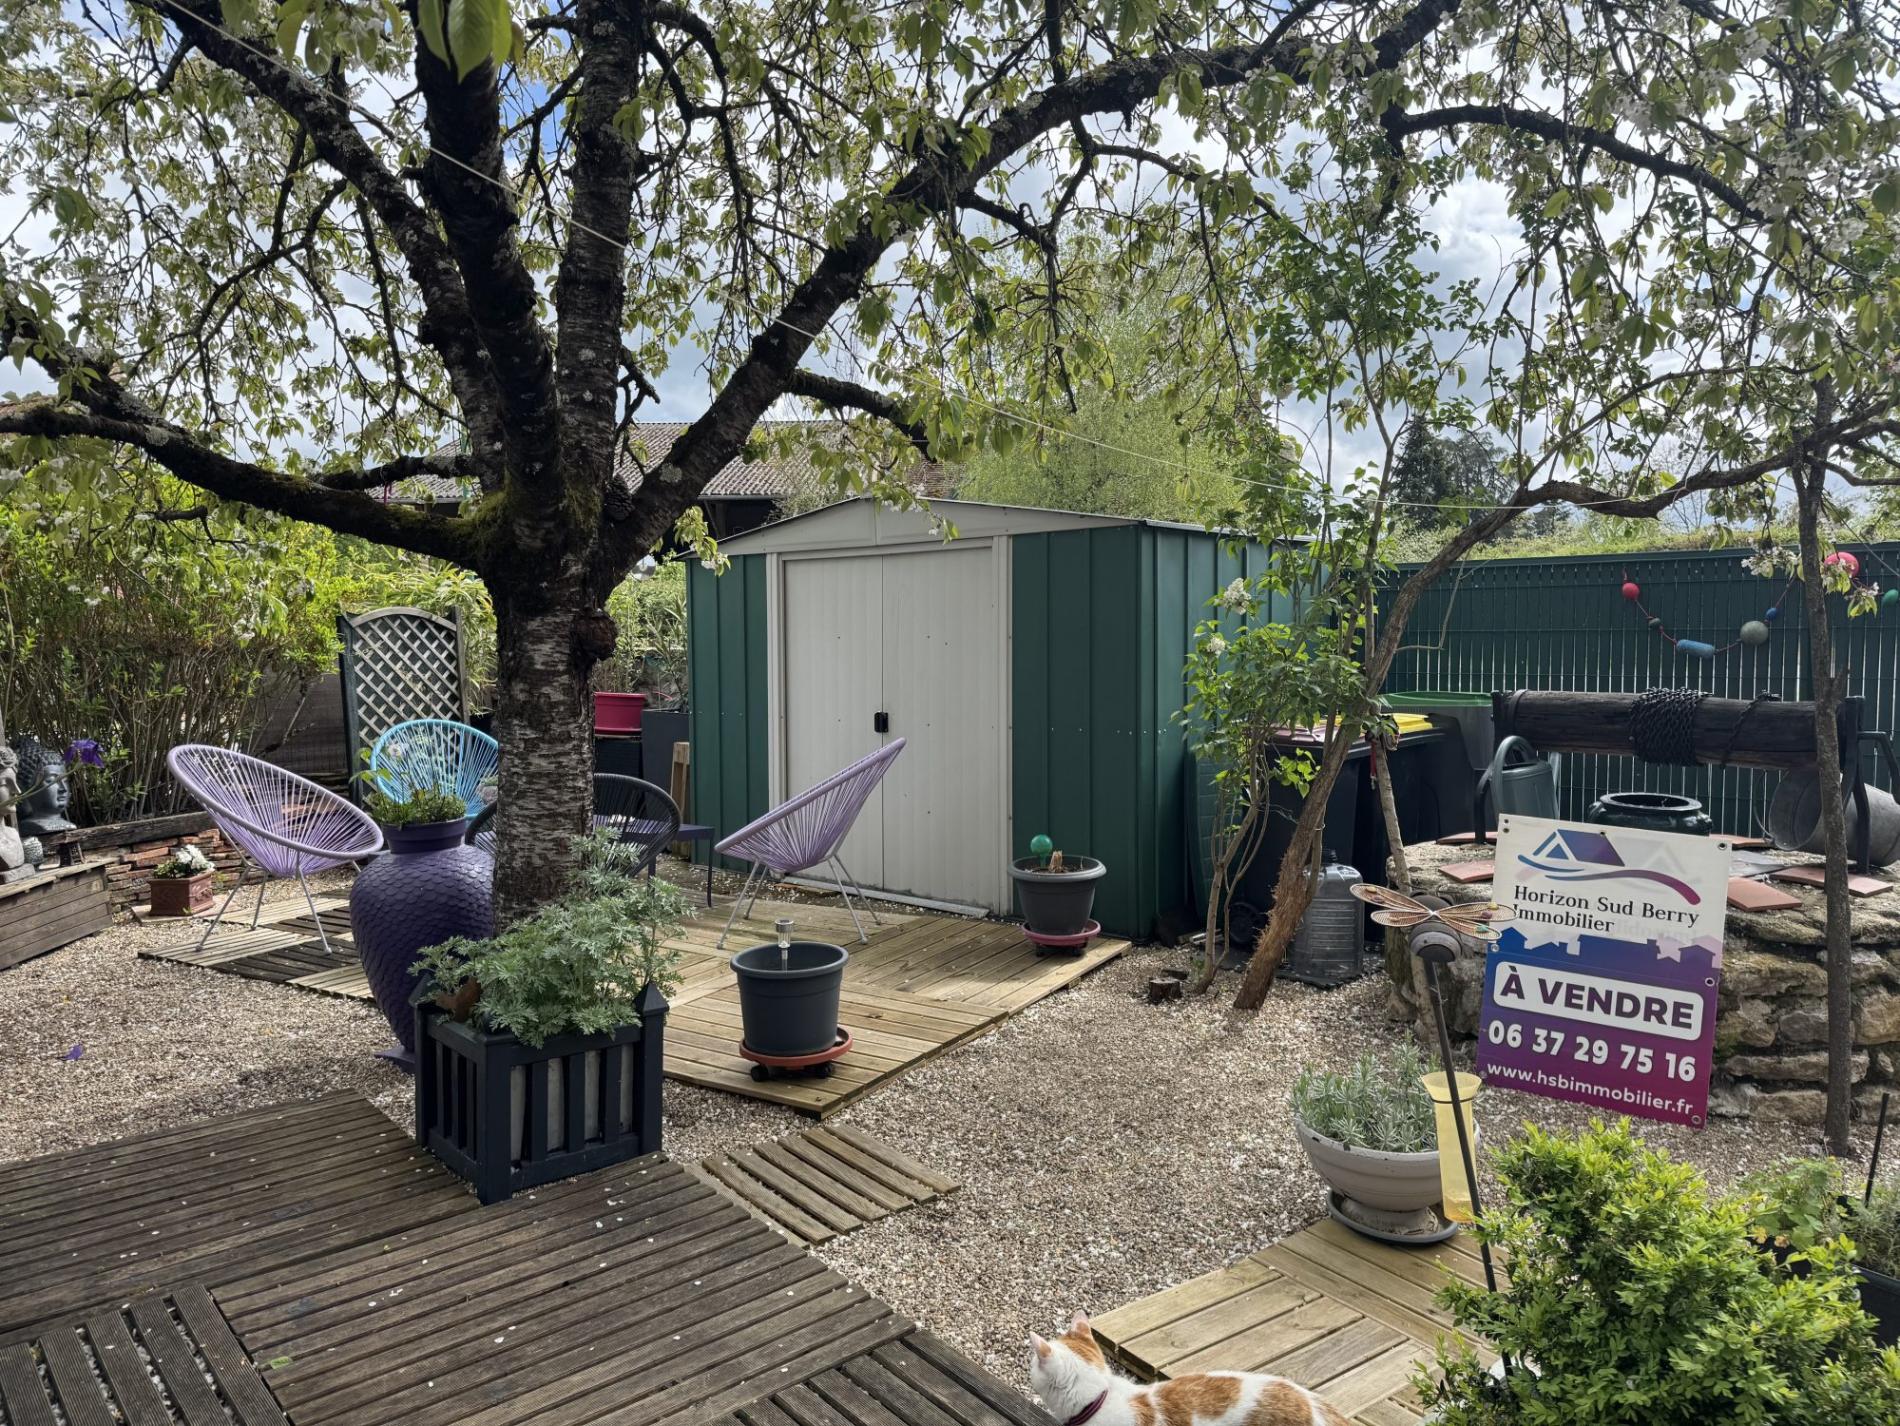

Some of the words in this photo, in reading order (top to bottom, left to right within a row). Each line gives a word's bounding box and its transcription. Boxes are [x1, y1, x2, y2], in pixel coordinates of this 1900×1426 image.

[1514, 885, 1589, 910] Horizon
[1597, 896, 1633, 916] Sud
[1642, 903, 1700, 928] Berry
[1500, 965, 1526, 1000] À
[1538, 978, 1694, 1030] VENDRE
[1488, 1020, 1522, 1048] 06
[1532, 1027, 1565, 1056] 37
[1574, 1036, 1609, 1065] 29
[1620, 1044, 1653, 1074] 75
[1665, 1052, 1696, 1082] 16
[1487, 1063, 1694, 1115] www.hsbimmobilier.fr
